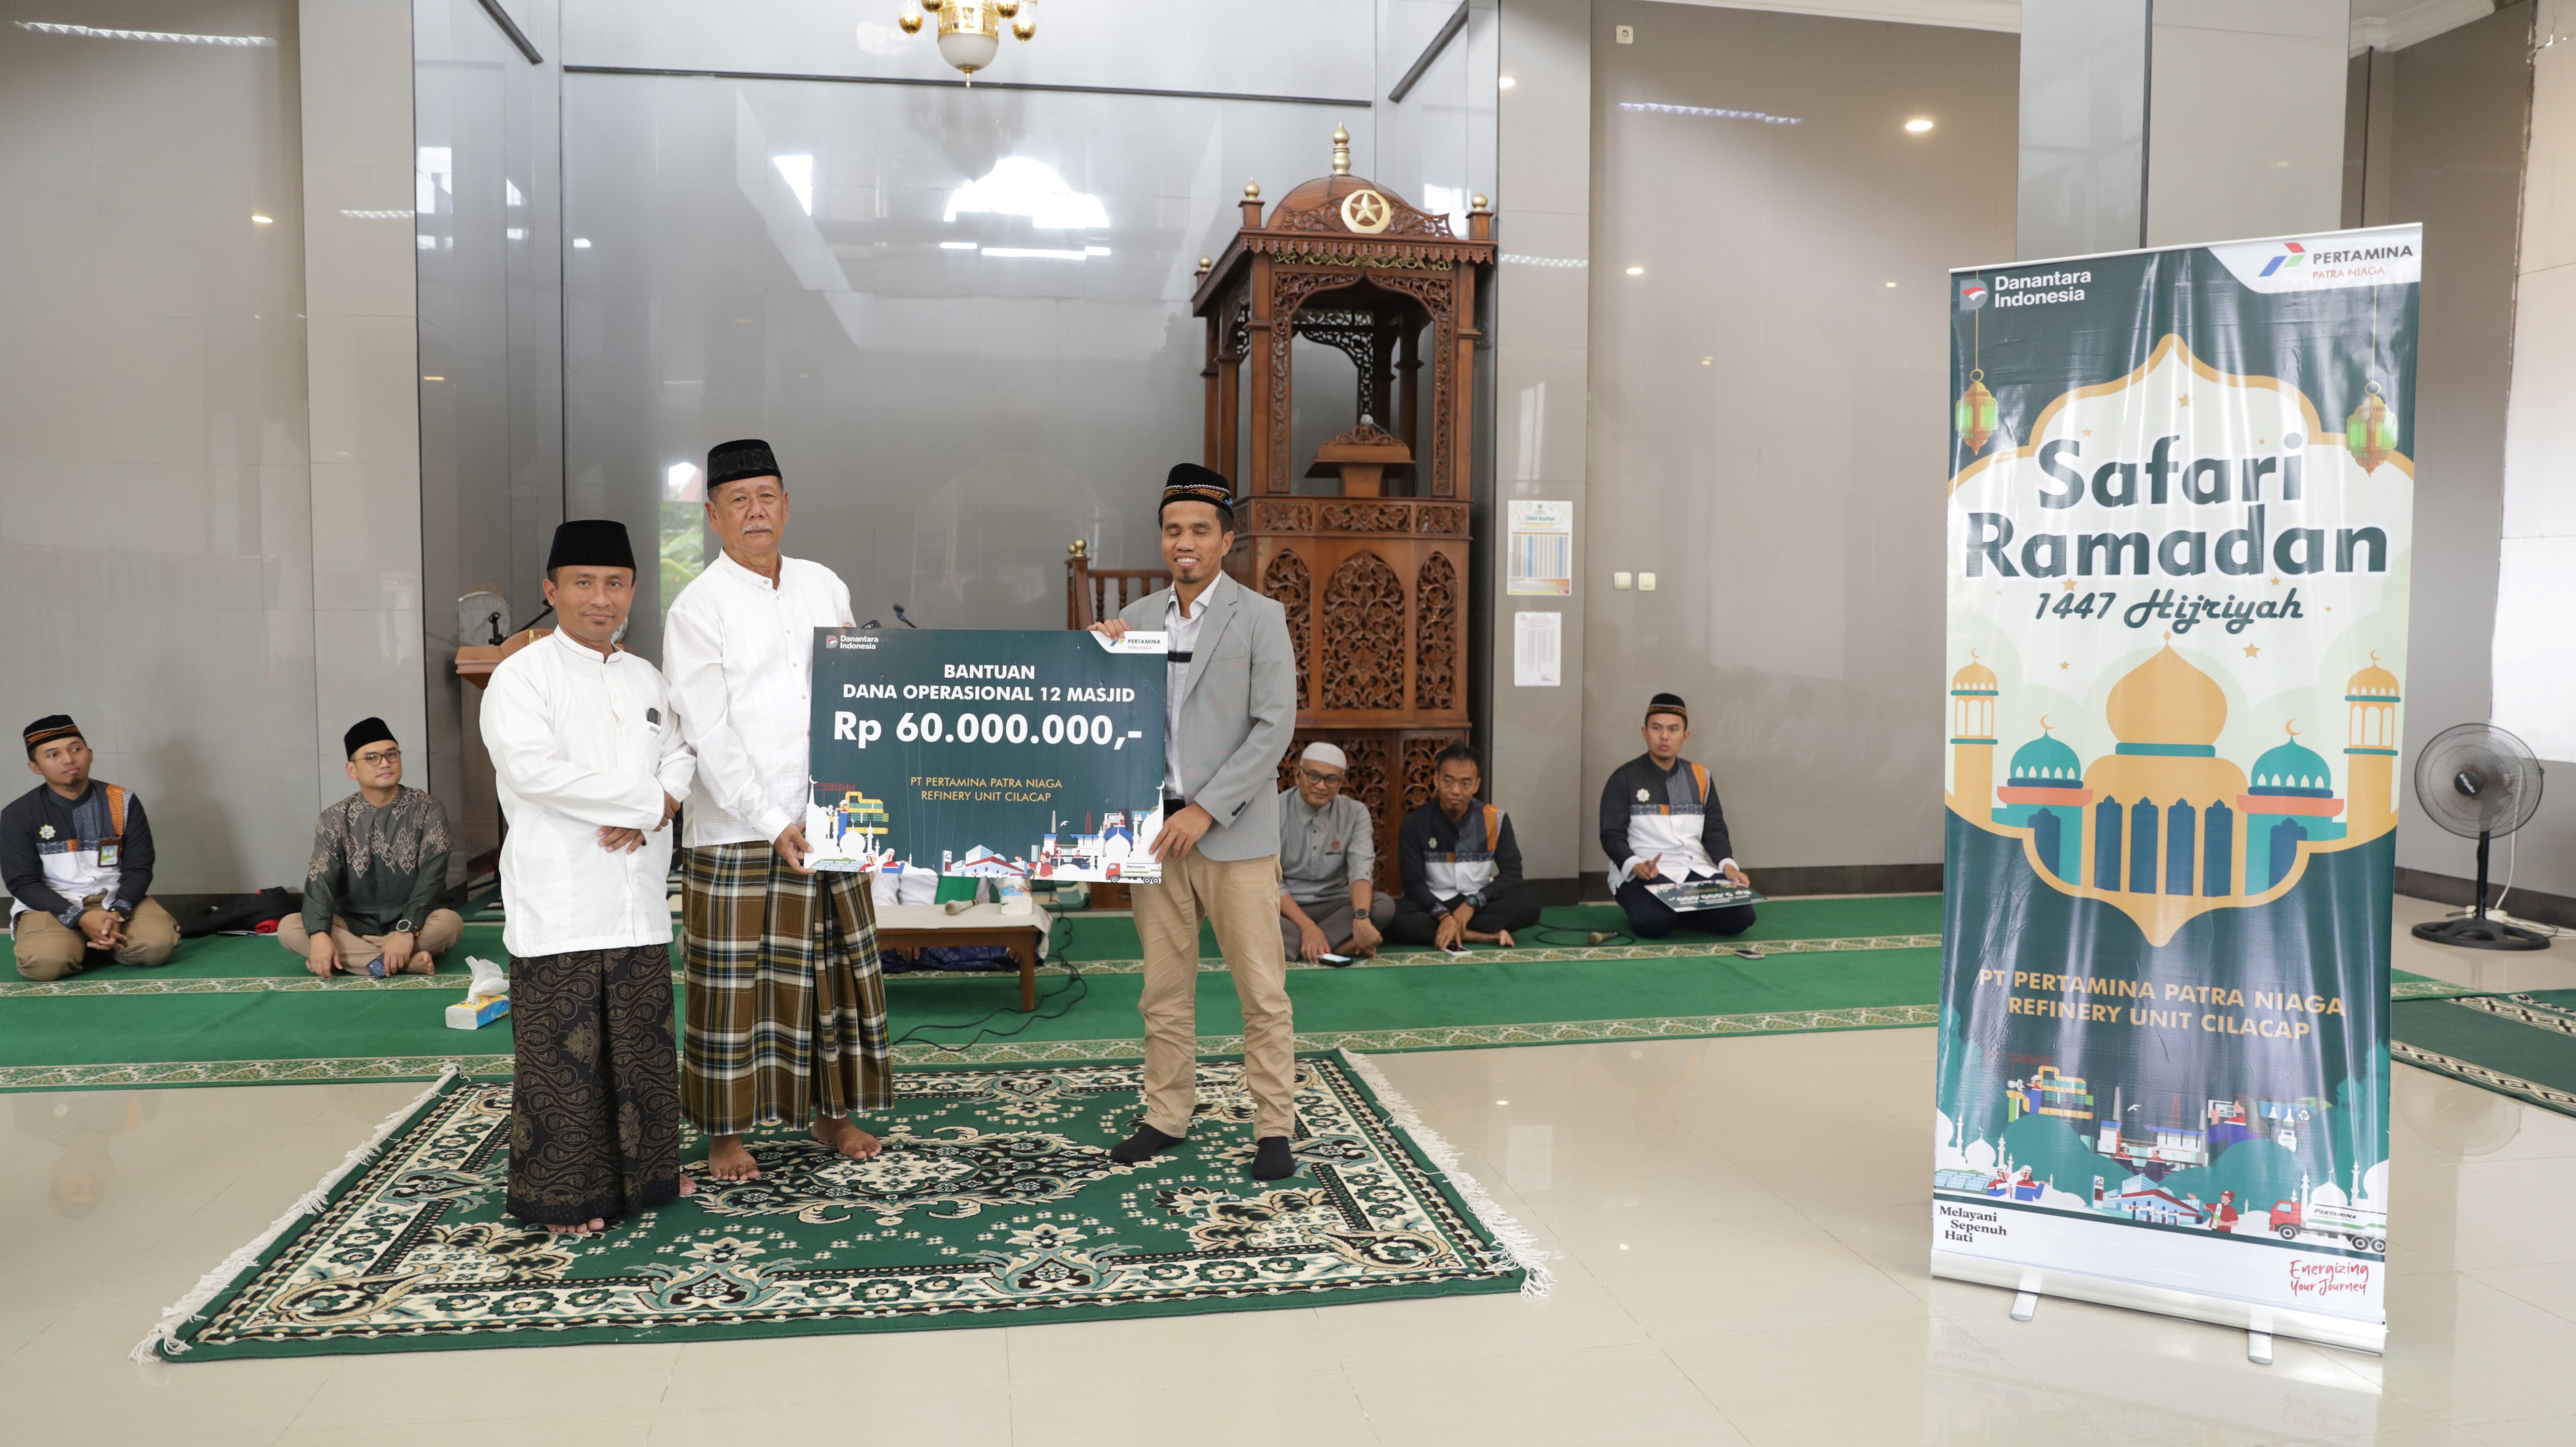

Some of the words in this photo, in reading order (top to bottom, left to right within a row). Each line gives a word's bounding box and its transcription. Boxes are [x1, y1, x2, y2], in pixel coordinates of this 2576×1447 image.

[2313, 246, 2413, 265] PERTAMINA
[1995, 271, 2091, 291] Danantara
[2313, 269, 2344, 279] PATRA
[2348, 266, 2385, 277] NIAGA
[1995, 289, 2085, 308] Indonesia
[2039, 432, 2303, 509] Safari
[1966, 504, 2387, 578] Ramadan
[2036, 592, 2117, 619] 1447
[2124, 588, 2304, 635] Hijriyah
[944, 665, 1035, 679] BANTUAN
[843, 684, 897, 698] DANA
[903, 685, 1033, 701] OPERASIONAL
[1041, 687, 1061, 701] 12
[1067, 688, 1134, 702] MASJID
[834, 711, 881, 749] Rp
[896, 713, 1142, 750] 60.000.000,-
[911, 777, 922, 786] PT
[926, 777, 987, 787] PERTAMINA
[991, 778, 1023, 787] PATRA
[1027, 779, 1062, 788] NIAGA
[921, 791, 971, 800] REFINERY
[975, 792, 1002, 801] UNIT
[1005, 792, 1051, 802] CILACAP
[1980, 969, 2005, 986] PT
[2014, 971, 2154, 998] PERTAMINA
[2166, 984, 2245, 1007] PATRA
[2255, 992, 2344, 1015] NIAGA
[2008, 997, 2121, 1022] REFINERY
[2129, 1008, 2191, 1030] UNIT
[2201, 1014, 2310, 1038] CILACAP
[1940, 1206, 1997, 1222] Melayani
[2314, 1209, 2356, 1219] PERTAMINA
[1951, 1219, 2007, 1236] Sepenuh
[1945, 1231, 1973, 1243] Hati
[2290, 1260, 2369, 1283] Energizing
[2290, 1280, 2315, 1297] Your
[2319, 1279, 2367, 1296] Journey
